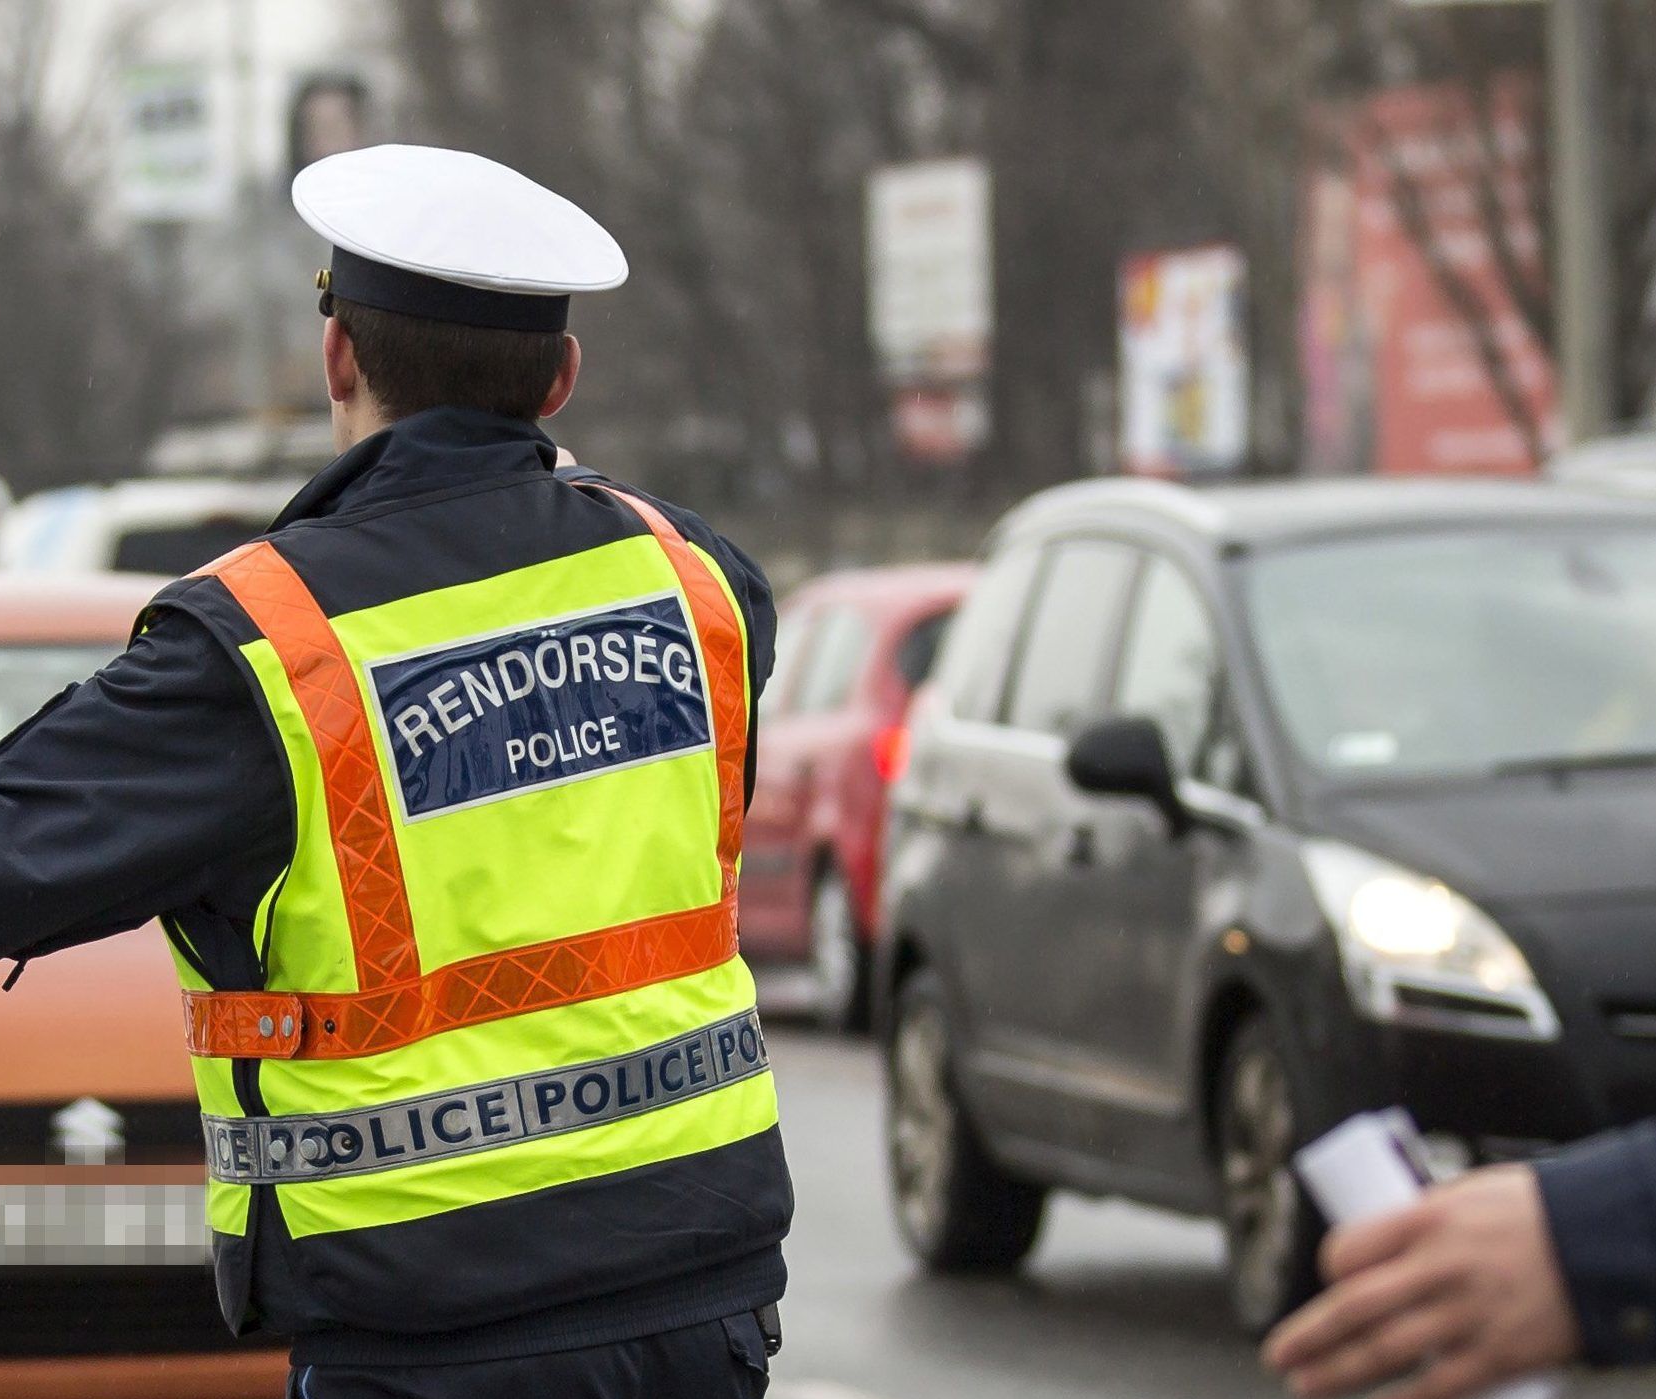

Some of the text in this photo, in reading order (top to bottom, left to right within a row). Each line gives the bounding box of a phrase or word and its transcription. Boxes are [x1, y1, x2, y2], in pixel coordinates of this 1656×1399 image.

[505, 715, 621, 774] POLICE
[533, 1042, 707, 1126] POLICE
[717, 1023, 767, 1073] PO
